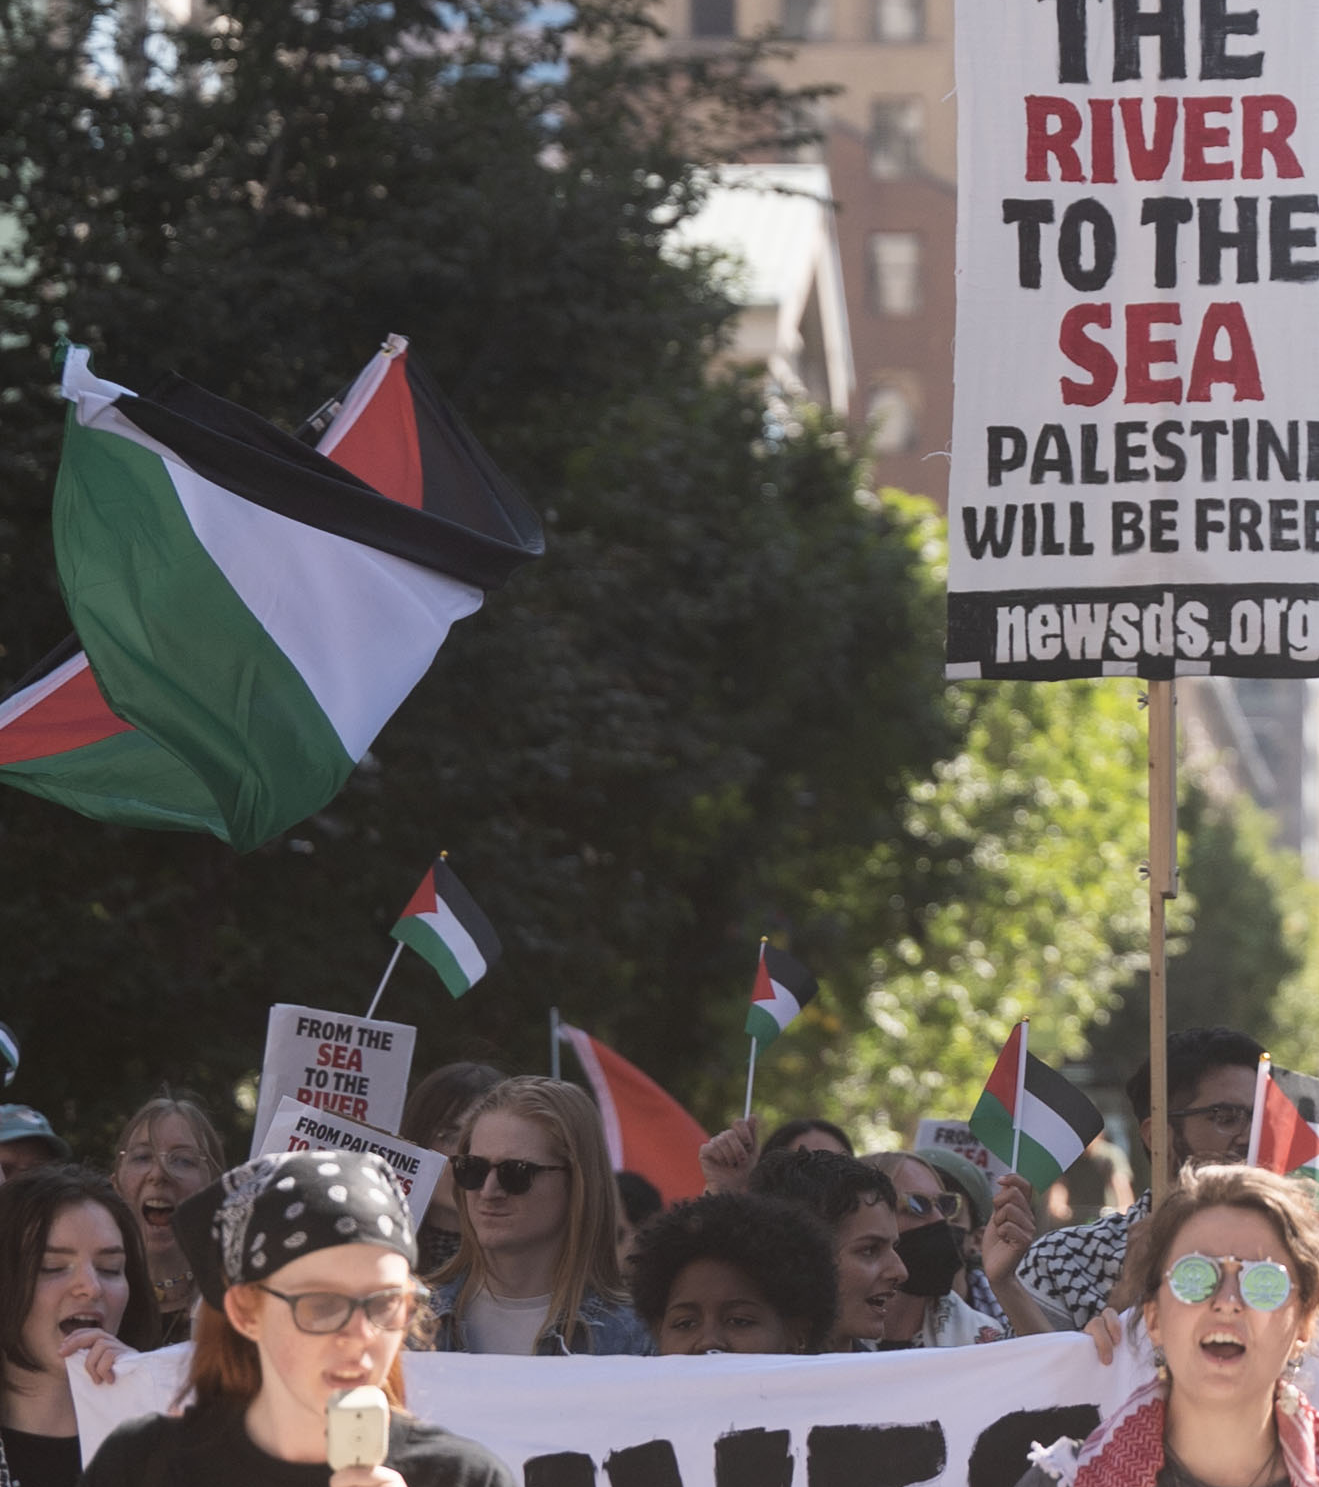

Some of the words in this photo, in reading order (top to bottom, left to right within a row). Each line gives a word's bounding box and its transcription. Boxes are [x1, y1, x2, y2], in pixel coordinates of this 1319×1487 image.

[1024, 94, 1304, 184] RIVER
[1002, 198, 1117, 292] TO
[1059, 301, 1266, 406] SEA
[962, 502, 1094, 561] WILL
[1112, 500, 1179, 555] BE
[296, 1017, 353, 1044] FROM
[357, 1027, 393, 1051] THE
[316, 1042, 363, 1072] SEA
[297, 1087, 369, 1122] RIVER
[304, 1067, 327, 1088] TO
[333, 1075, 370, 1096] THE
[295, 1116, 342, 1145] FROM
[341, 1132, 421, 1175] PALESTINE
